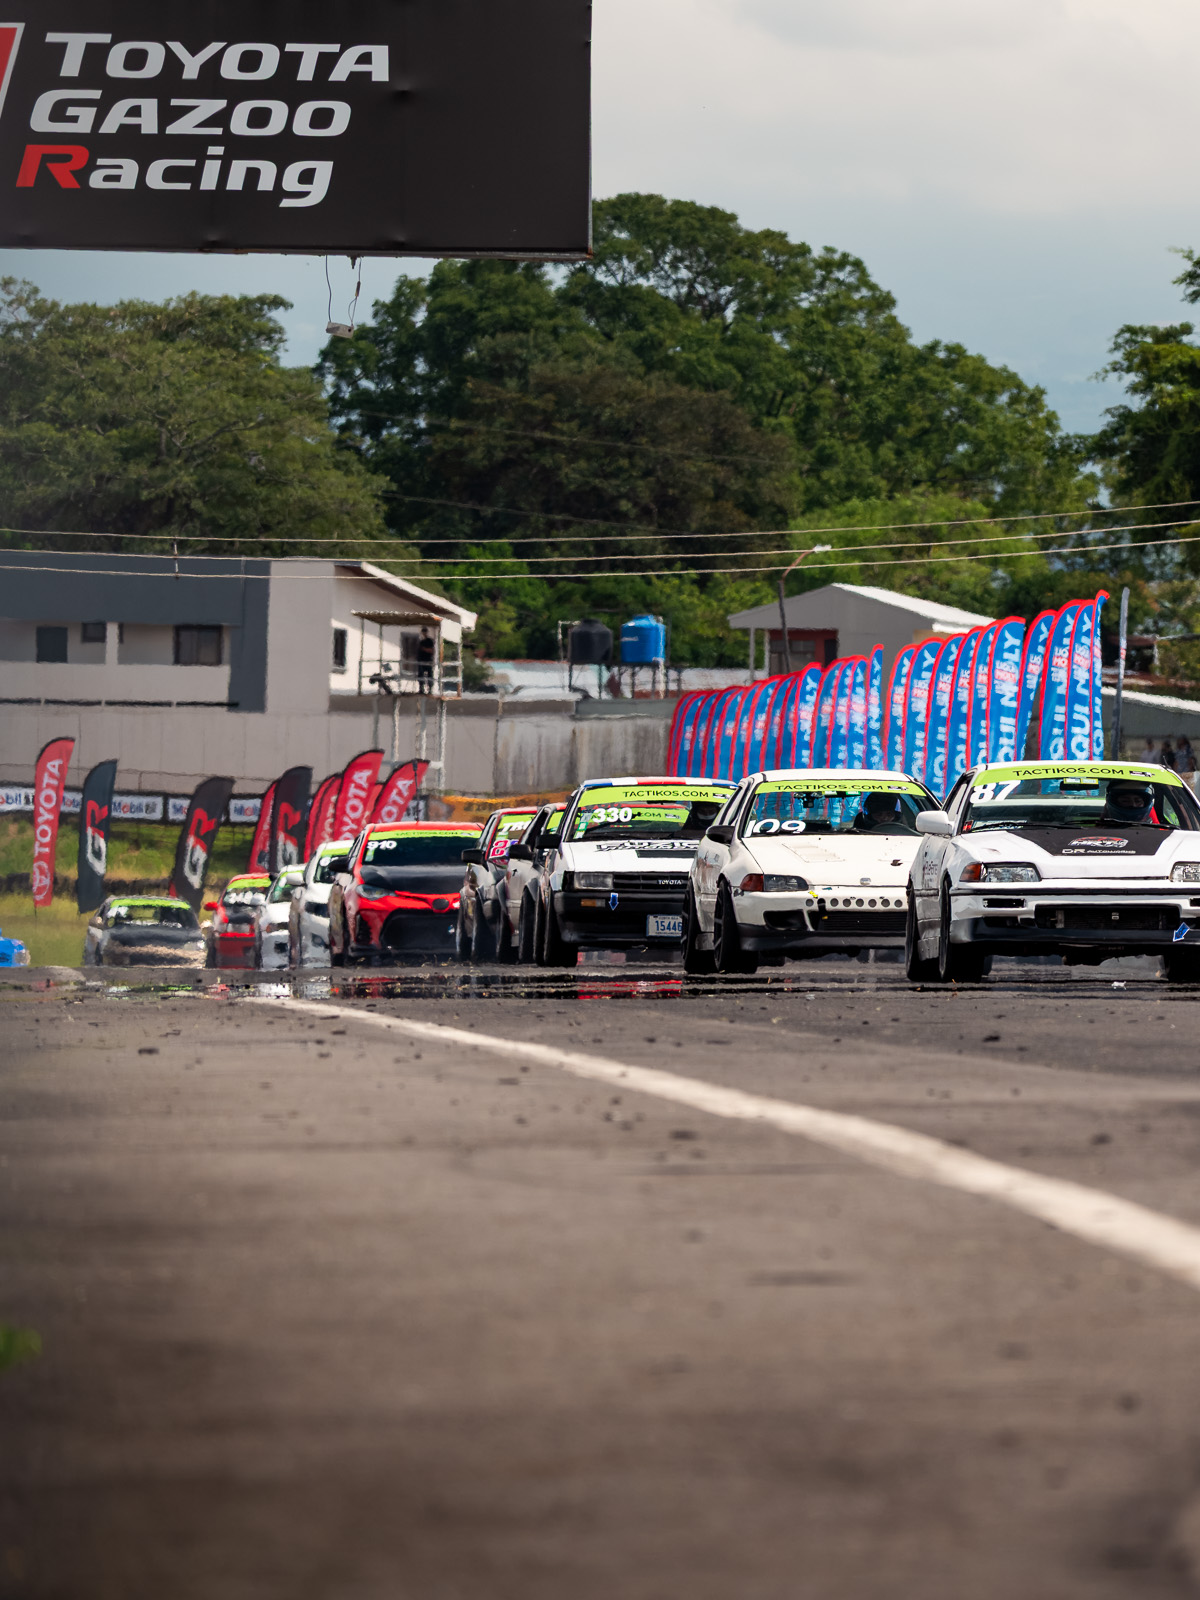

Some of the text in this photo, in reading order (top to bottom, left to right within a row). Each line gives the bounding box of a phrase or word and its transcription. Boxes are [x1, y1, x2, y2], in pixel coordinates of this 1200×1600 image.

[45, 32, 389, 82] TOYOTA
[30, 89, 352, 136] GAZOO
[15, 144, 334, 207] Racing
[622, 790, 709, 798] TACTIKOS.COM
[775, 784, 884, 792] TACTIKOS.COM
[969, 780, 1022, 804] 87
[1012, 767, 1124, 777] TACTIKOS.COM
[34, 759, 63, 857] TOYOTA
[339, 769, 373, 842] OYOTA
[592, 807, 633, 823] 330
[86, 800, 109, 877] GR
[183, 807, 217, 890] GR
[366, 840, 397, 850] 910
